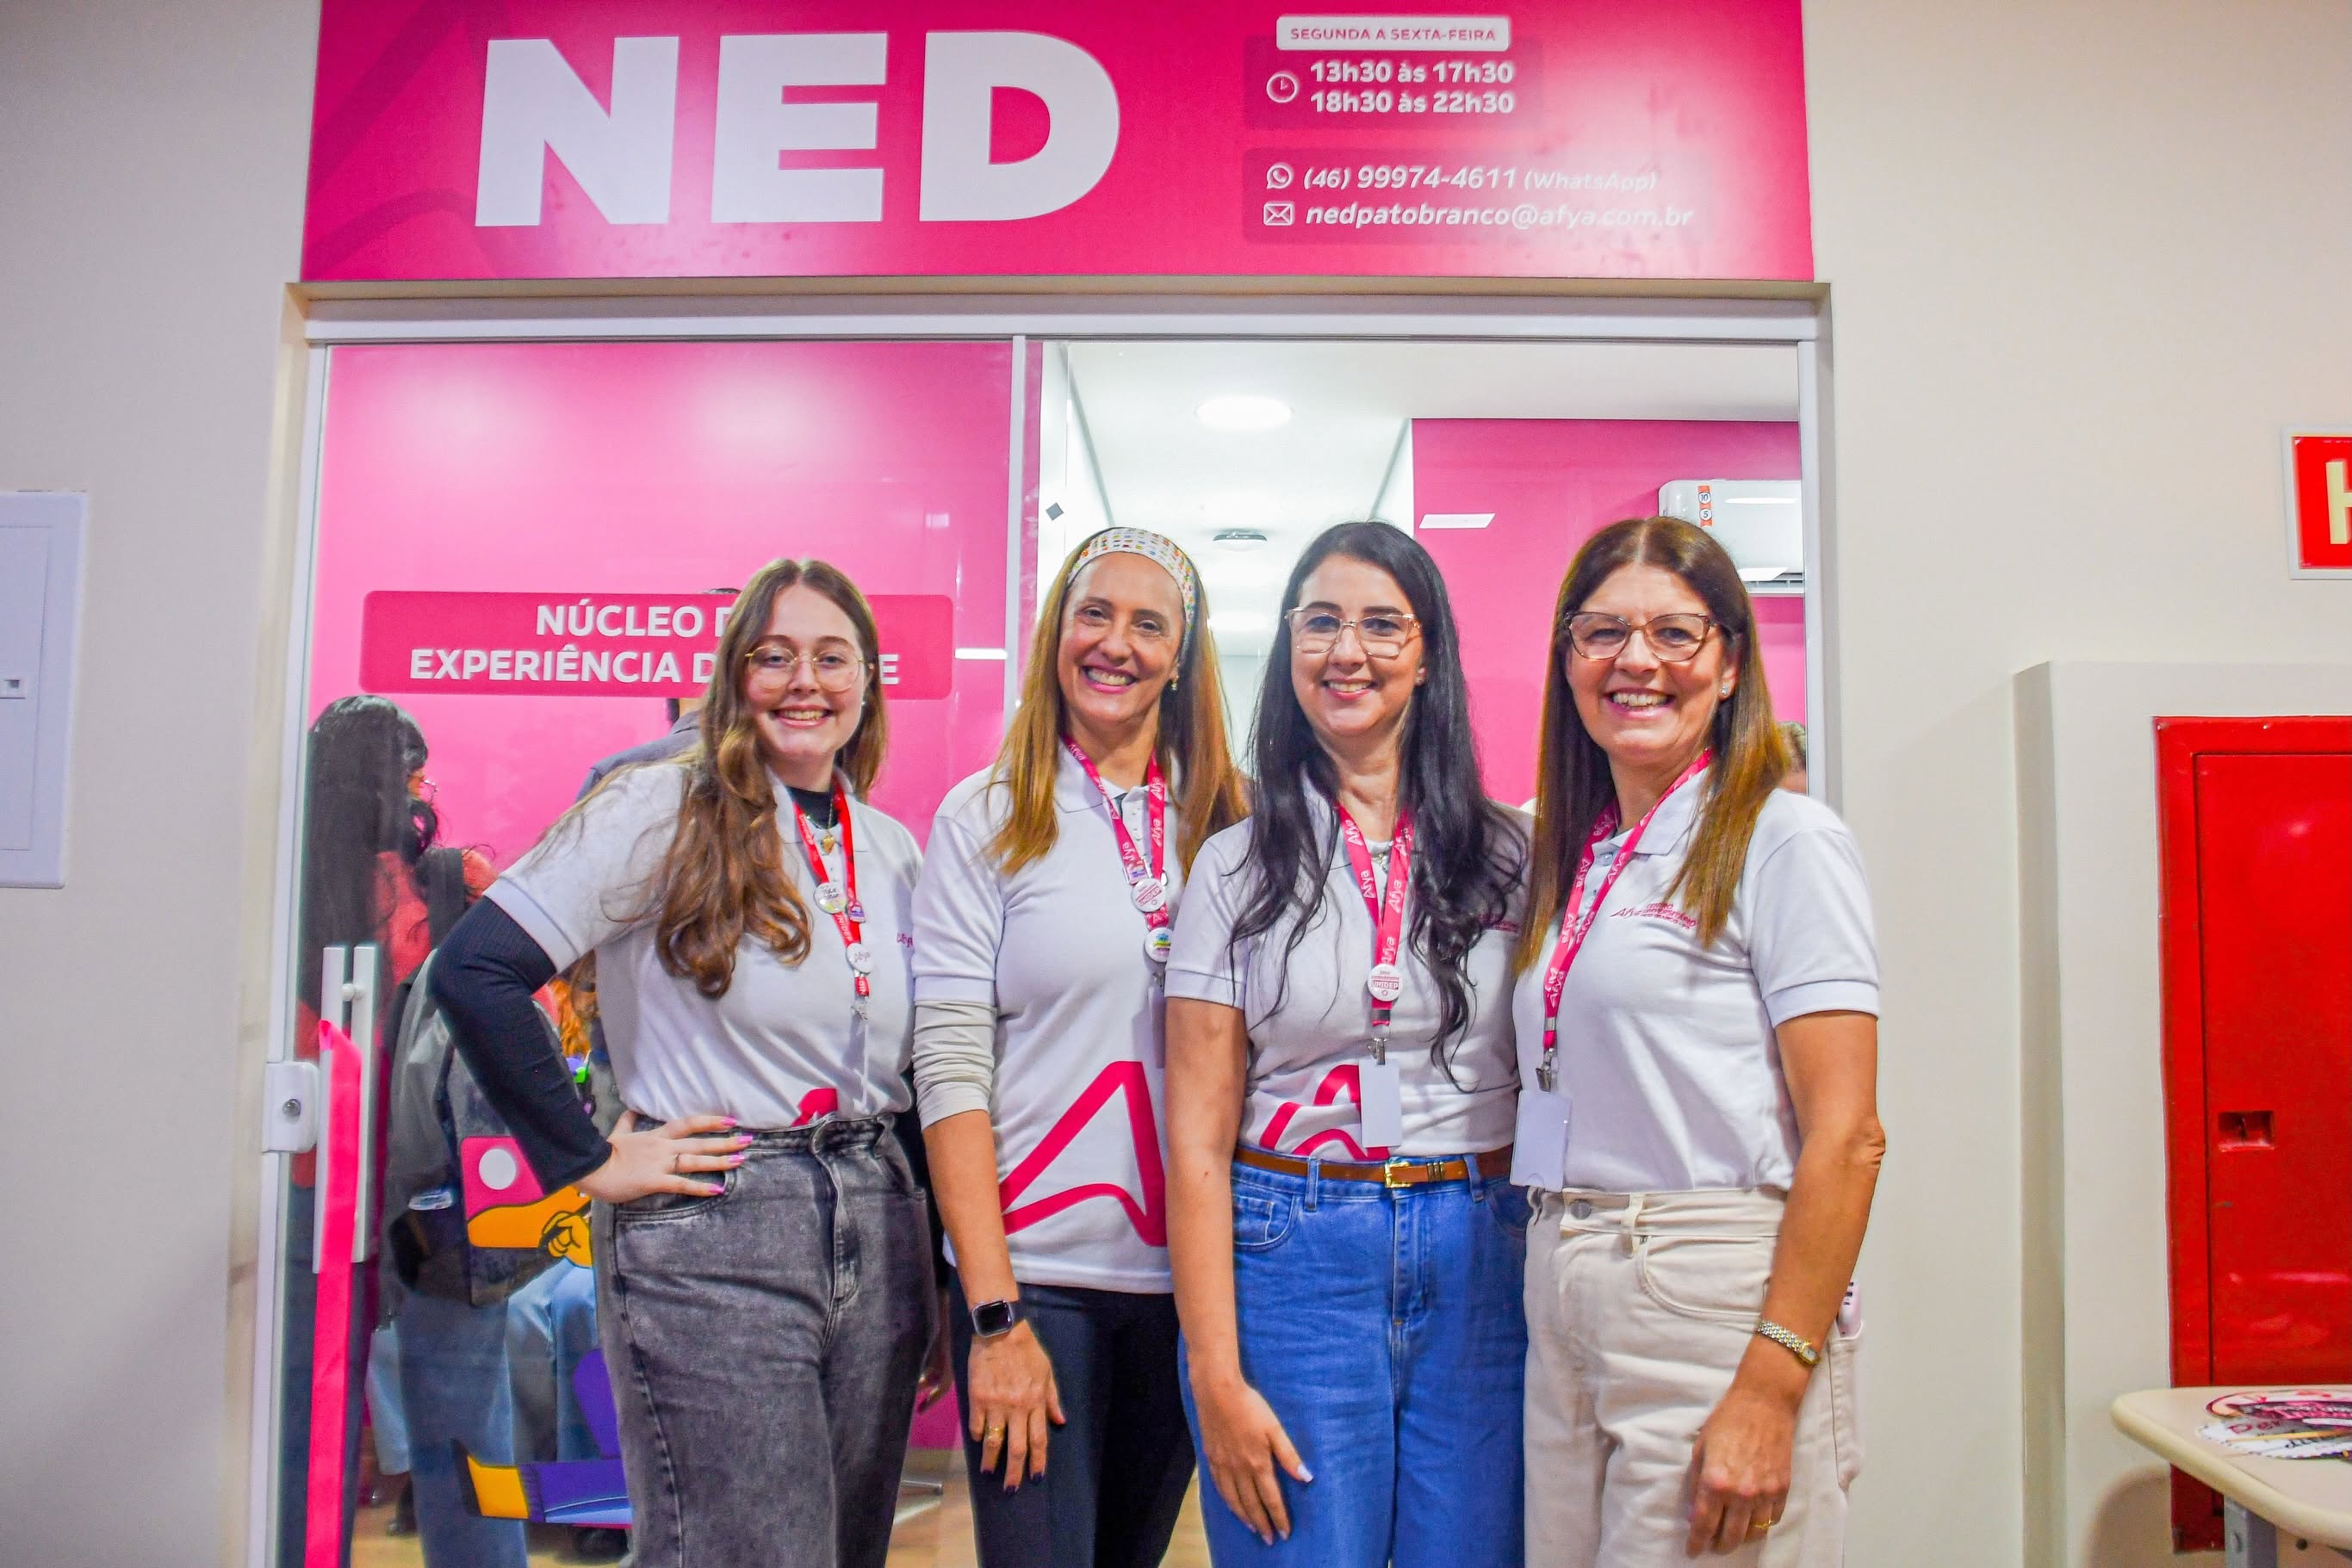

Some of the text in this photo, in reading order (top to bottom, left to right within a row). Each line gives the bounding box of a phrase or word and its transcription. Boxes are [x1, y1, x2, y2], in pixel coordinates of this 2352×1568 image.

[1290, 28, 1496, 41] SEGUNDA A SEXTA-FEIRA
[1310, 60, 1513, 84] 13h30 às 17h30
[1310, 90, 1514, 114] 18h30 às 22h30
[475, 31, 1119, 226] NED
[1303, 165, 1658, 193] (46) 99974-4611 (WhatsApp)
[1306, 200, 1695, 230] nedpatobranco@afya.com.br
[1700, 493, 1709, 502] 10
[536, 598, 704, 637] NÚCLEO
[410, 643, 681, 684] EXPERIÊNCIA
